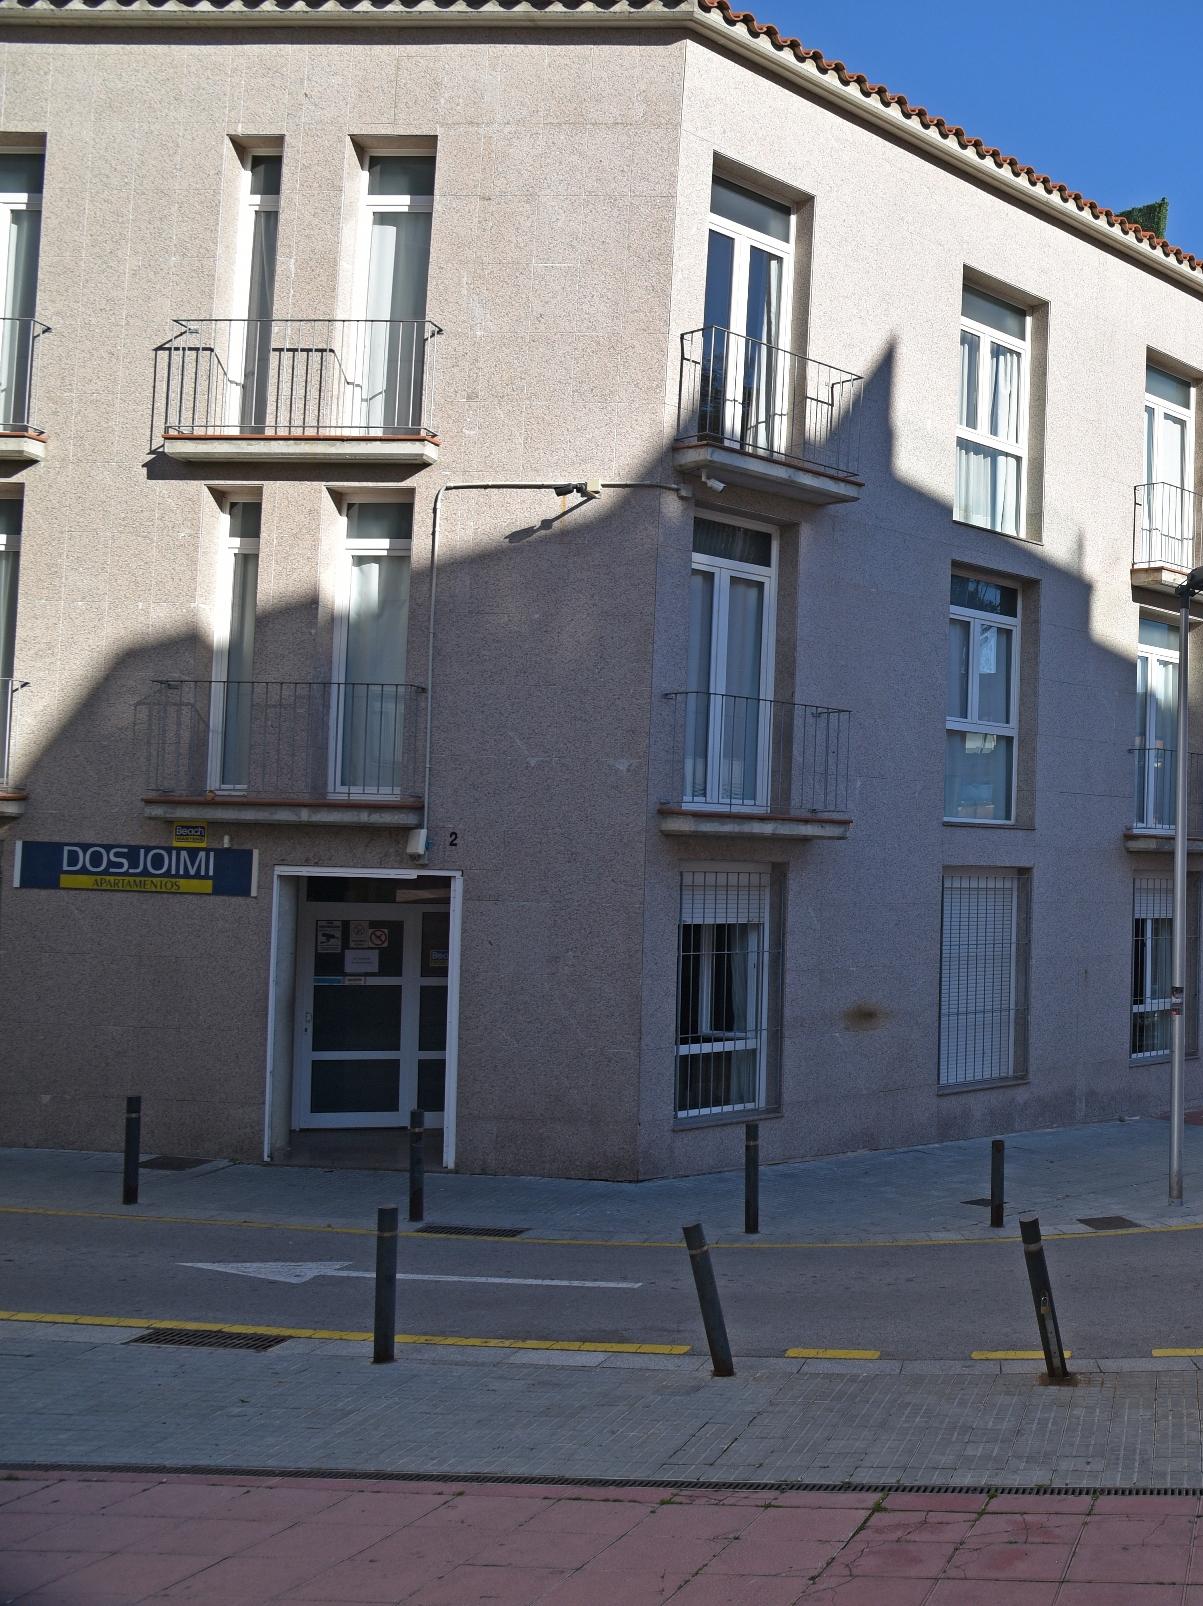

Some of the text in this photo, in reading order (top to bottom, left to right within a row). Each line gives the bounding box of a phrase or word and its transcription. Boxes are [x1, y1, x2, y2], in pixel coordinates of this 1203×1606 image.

[176, 826, 205, 836] Beach
[449, 831, 457, 846] 2
[63, 846, 214, 876] DOSJOIMI
[92, 877, 181, 890] APARTAMENTOS
[432, 951, 448, 960] Bea
